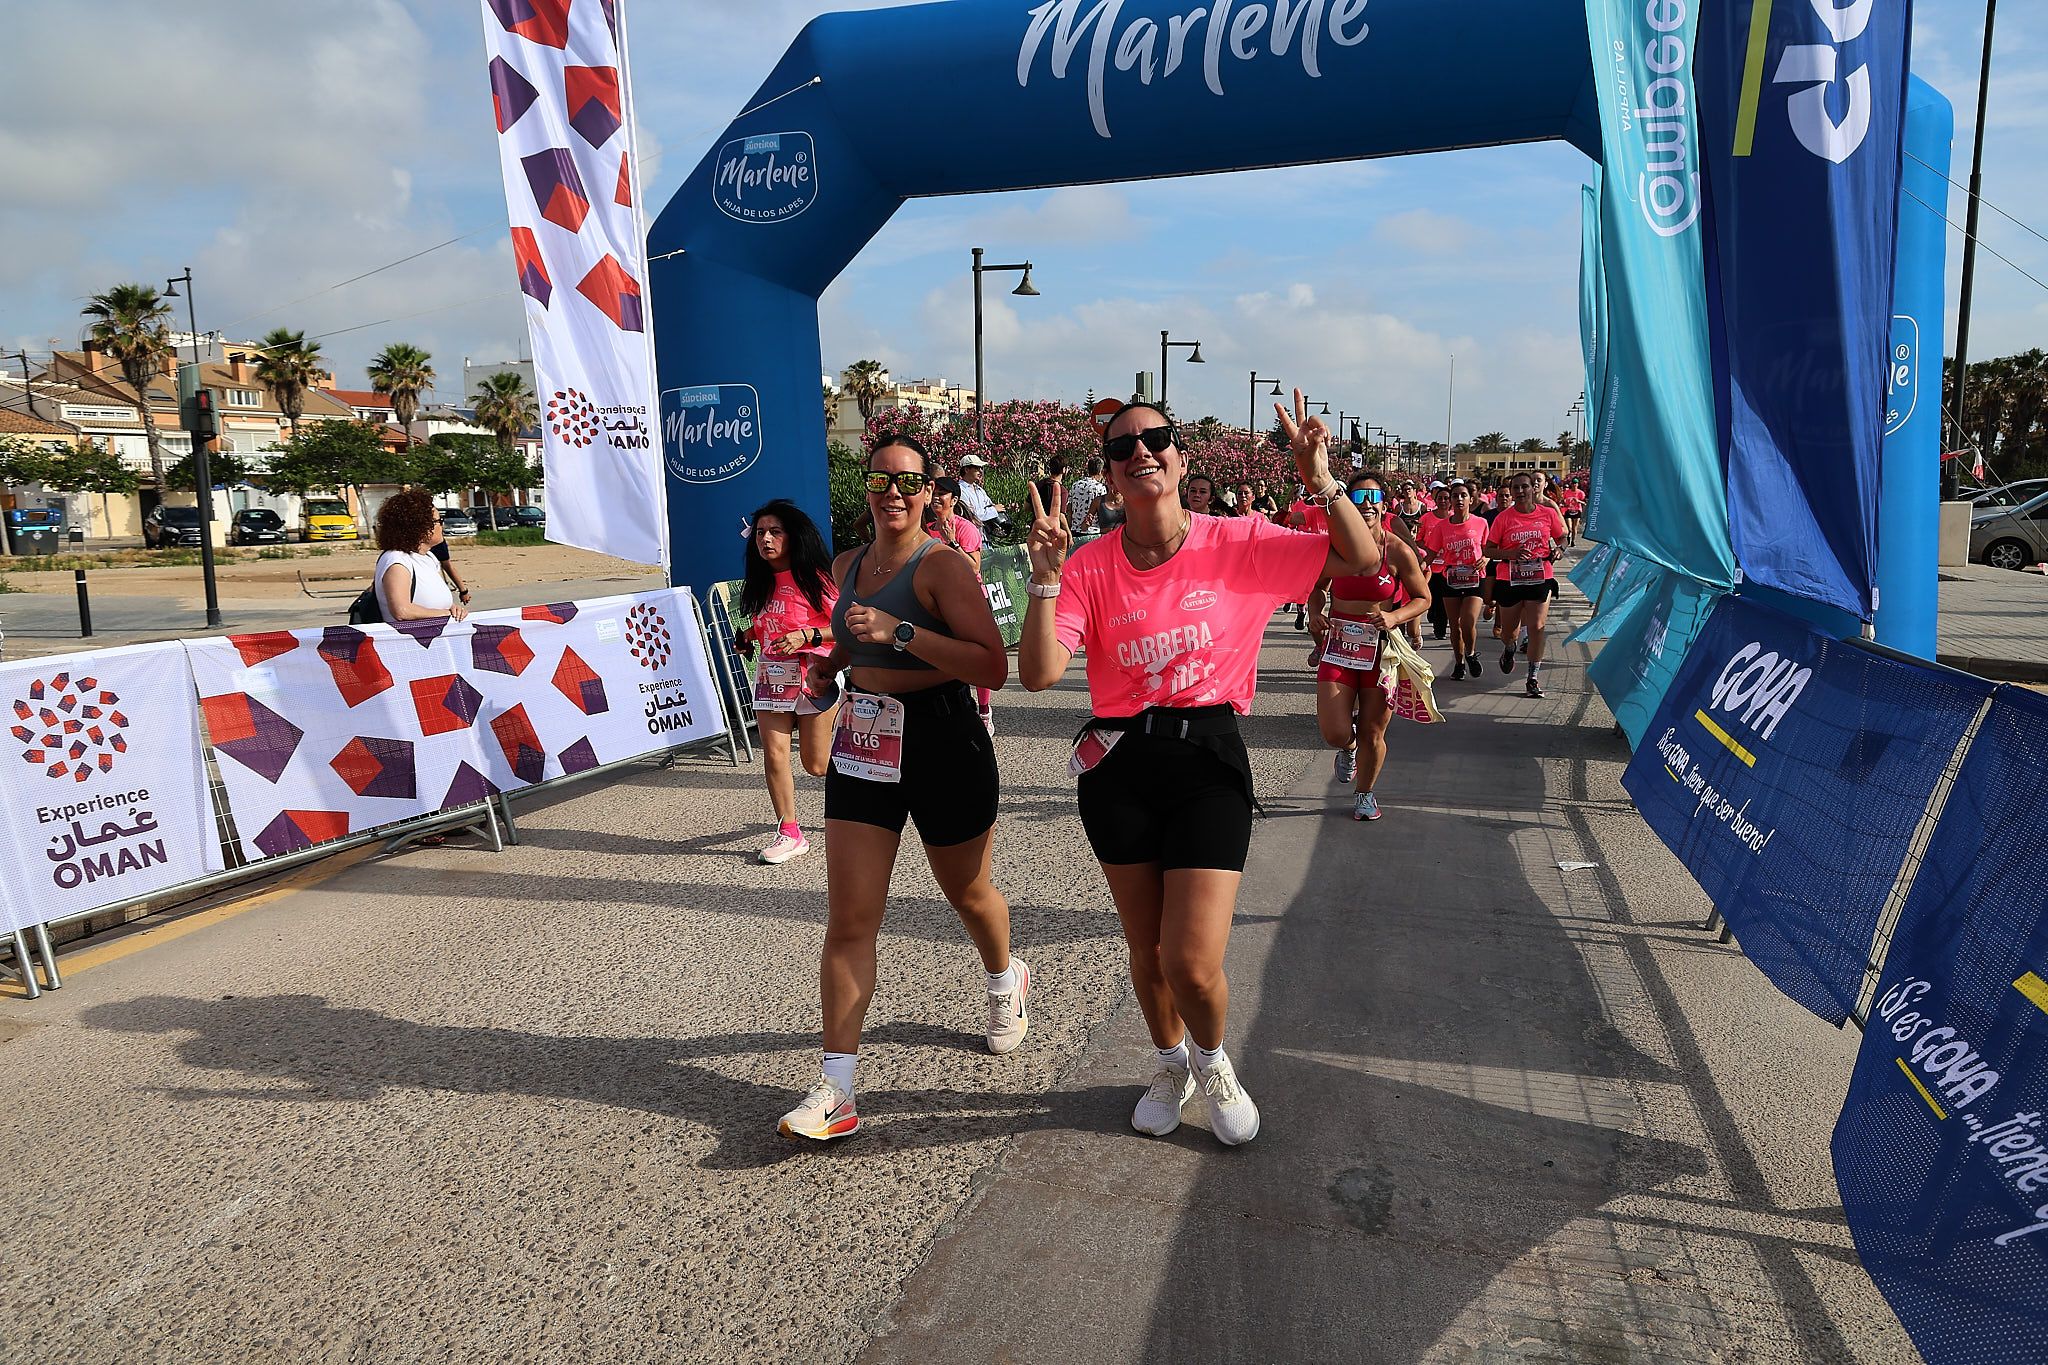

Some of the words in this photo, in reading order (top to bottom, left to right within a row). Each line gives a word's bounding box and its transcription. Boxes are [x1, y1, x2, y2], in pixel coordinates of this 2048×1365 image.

[1017, 0, 1369, 138] Marlene
[720, 153, 809, 200] Marlene
[723, 198, 741, 214] HIJA
[743, 208, 756, 217] DE
[758, 209, 776, 218] LOS
[778, 197, 804, 216] ALPES
[666, 406, 753, 459] Marlene
[670, 457, 684, 473] HIJA
[686, 467, 697, 477] DE
[698, 468, 716, 477] LOS
[719, 454, 747, 475] ALPES
[1108, 609, 1147, 629] OYSHO
[1117, 621, 1214, 667] CARRERA
[1342, 641, 1360, 652] 016
[639, 678, 683, 694] Experience
[771, 684, 785, 693] 16
[1711, 641, 1812, 741] GOYA
[647, 710, 693, 735] OMAN
[852, 732, 880, 749] 016
[36, 788, 150, 824] Experience
[1667, 743, 1690, 776] GOYA
[1694, 785, 1720, 818] que
[1715, 798, 1735, 822] ser
[1730, 798, 1775, 855] bueno!
[53, 838, 168, 889] OMAN
[1891, 1011, 1933, 1042] es
[1910, 1026, 2000, 1109] GOYA
